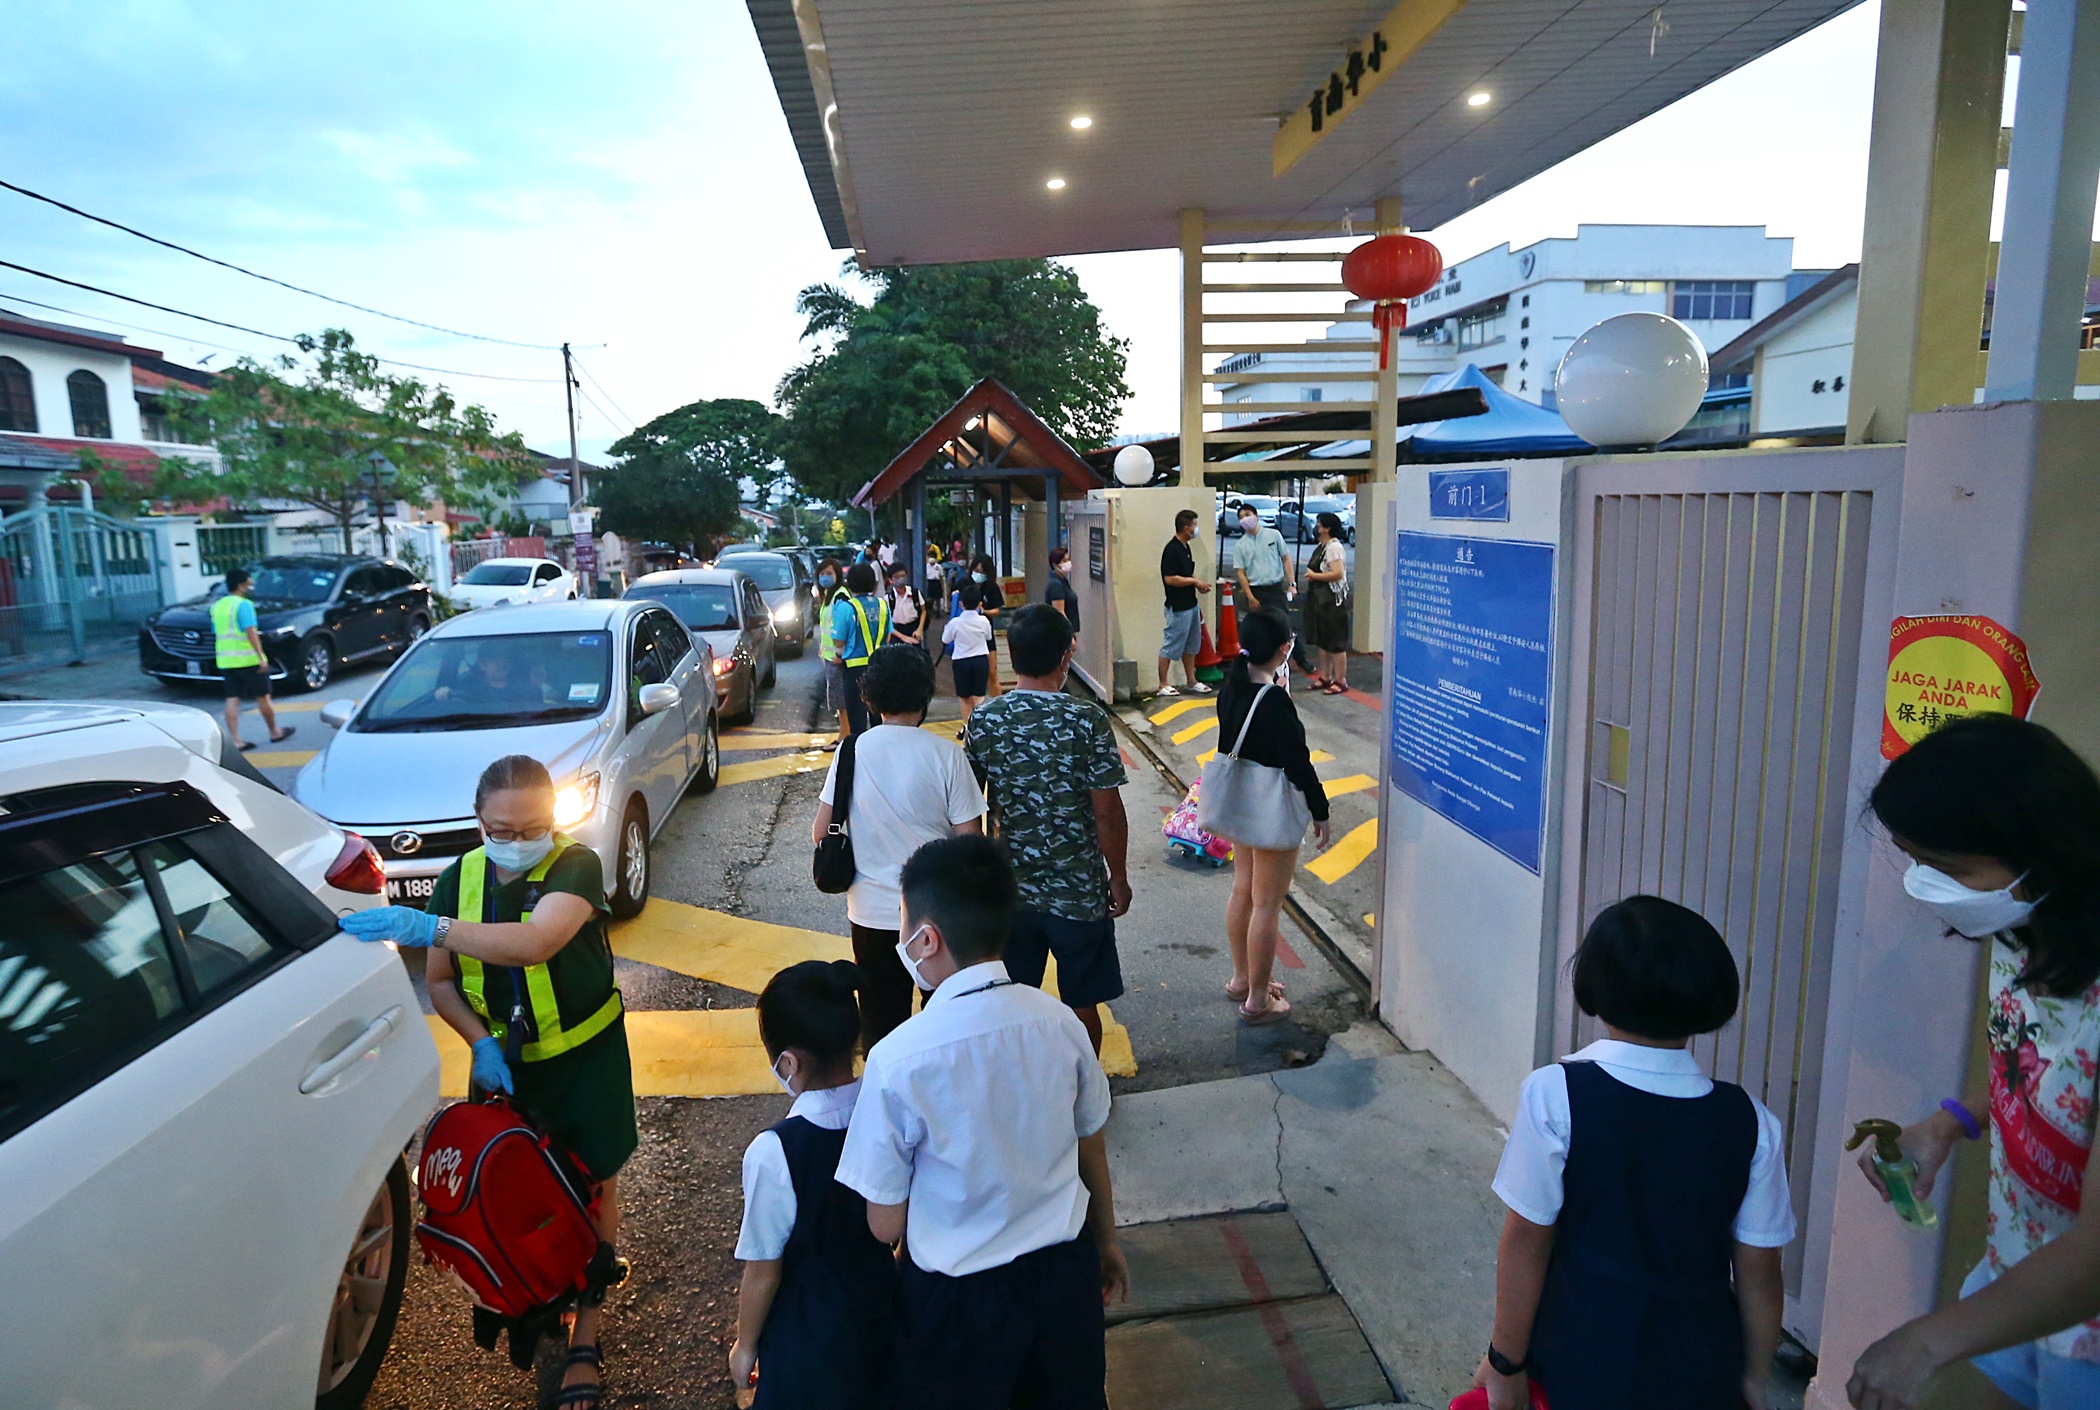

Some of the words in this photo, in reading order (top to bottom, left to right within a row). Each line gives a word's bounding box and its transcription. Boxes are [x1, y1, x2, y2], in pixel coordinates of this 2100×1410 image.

[1448, 484, 1472, 506] 前门
[1953, 615, 1982, 630] DAN
[1983, 626, 2027, 664] ORANG
[2020, 662, 2036, 690] LAIN
[1438, 678, 1482, 701] PEMBERITAHUAN
[1892, 670, 1939, 690] JAGA
[1943, 679, 2002, 700] JARAK
[1918, 690, 1969, 710] ANDA
[404, 878, 437, 897] 188
